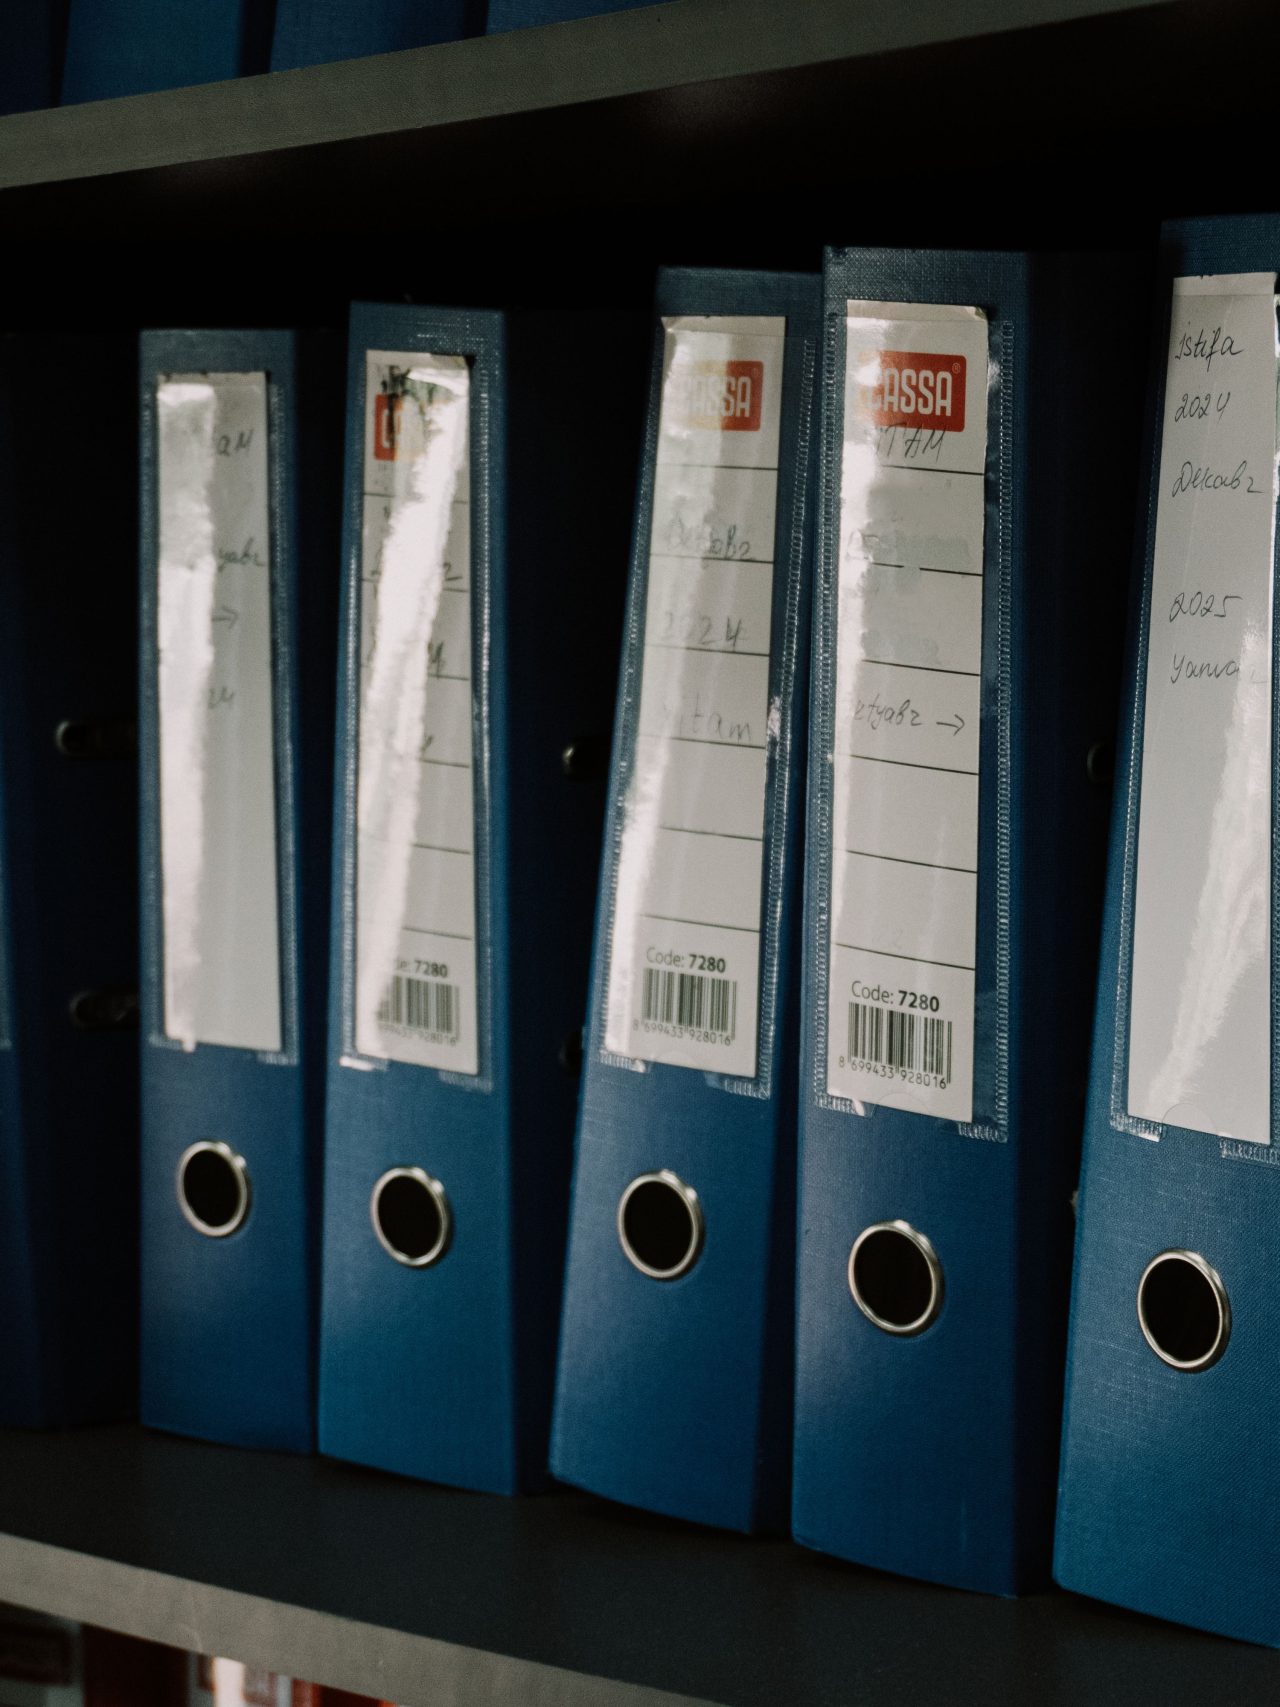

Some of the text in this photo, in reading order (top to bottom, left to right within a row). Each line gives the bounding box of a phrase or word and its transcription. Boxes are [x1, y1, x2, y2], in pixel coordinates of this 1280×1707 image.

[1174, 391, 1231, 424] 2024
[1169, 591, 1243, 623] 2025
[854, 693, 922, 730] ktyabr
[414, 957, 448, 979] 7280
[646, 946, 727, 974] Code: 7280
[851, 980, 940, 1012] Code: 7280
